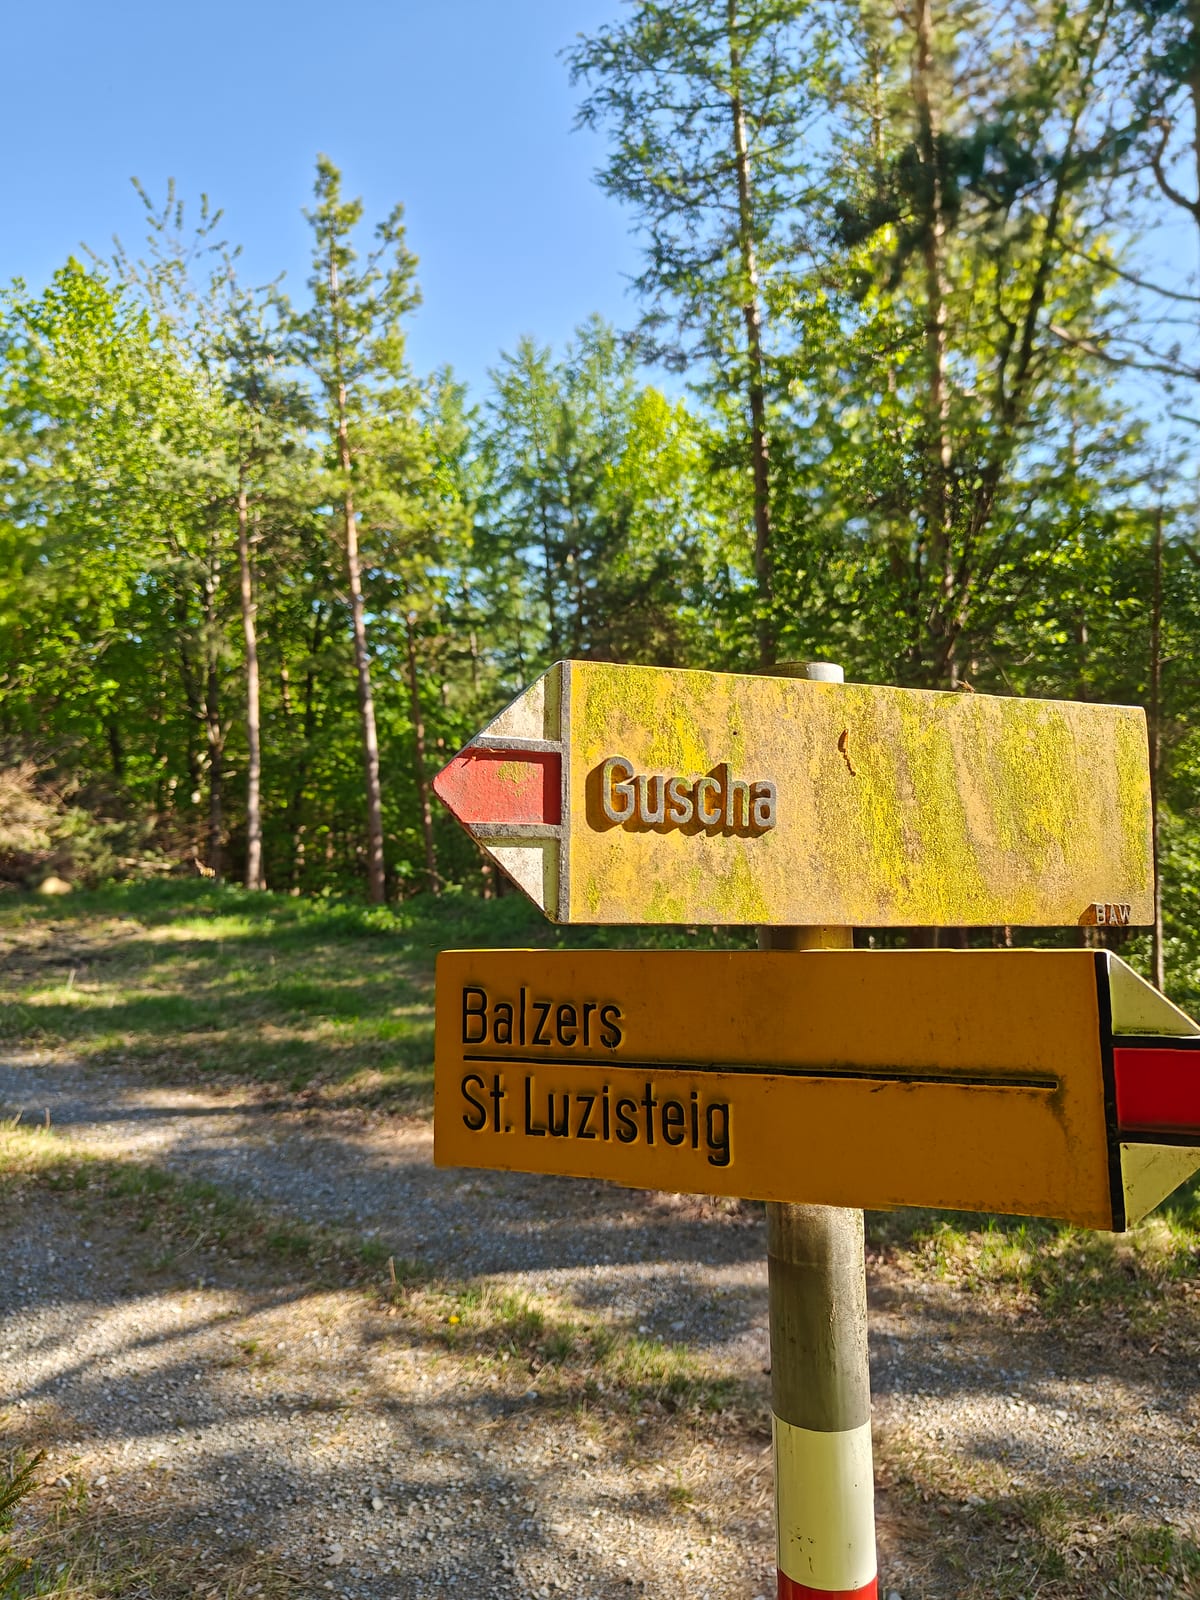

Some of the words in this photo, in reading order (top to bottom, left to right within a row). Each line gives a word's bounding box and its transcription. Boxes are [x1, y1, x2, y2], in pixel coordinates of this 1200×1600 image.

[602, 755, 777, 827] Guscha
[1095, 903, 1131, 926] BAW
[461, 986, 623, 1049] Balzers
[460, 1074, 512, 1133] St.
[524, 1076, 732, 1167] Luzisteig
